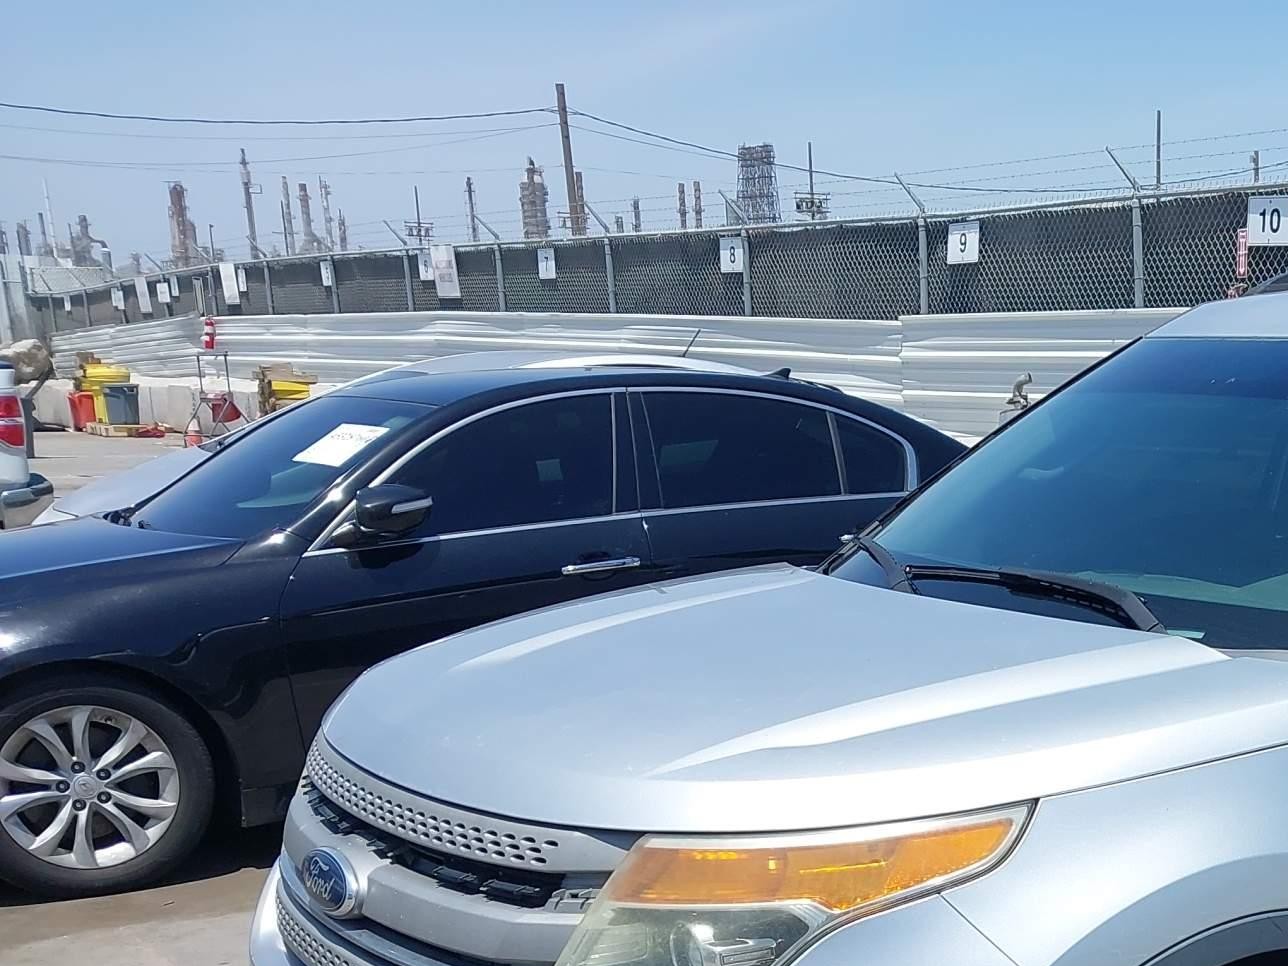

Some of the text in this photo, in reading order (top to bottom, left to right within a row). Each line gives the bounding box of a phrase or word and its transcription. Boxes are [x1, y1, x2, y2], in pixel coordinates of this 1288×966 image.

[1259, 207, 1282, 234] 10
[959, 232, 967, 254] 9
[543, 256, 549, 273] 7
[729, 245, 736, 264] 8
[303, 856, 336, 901] Ford
